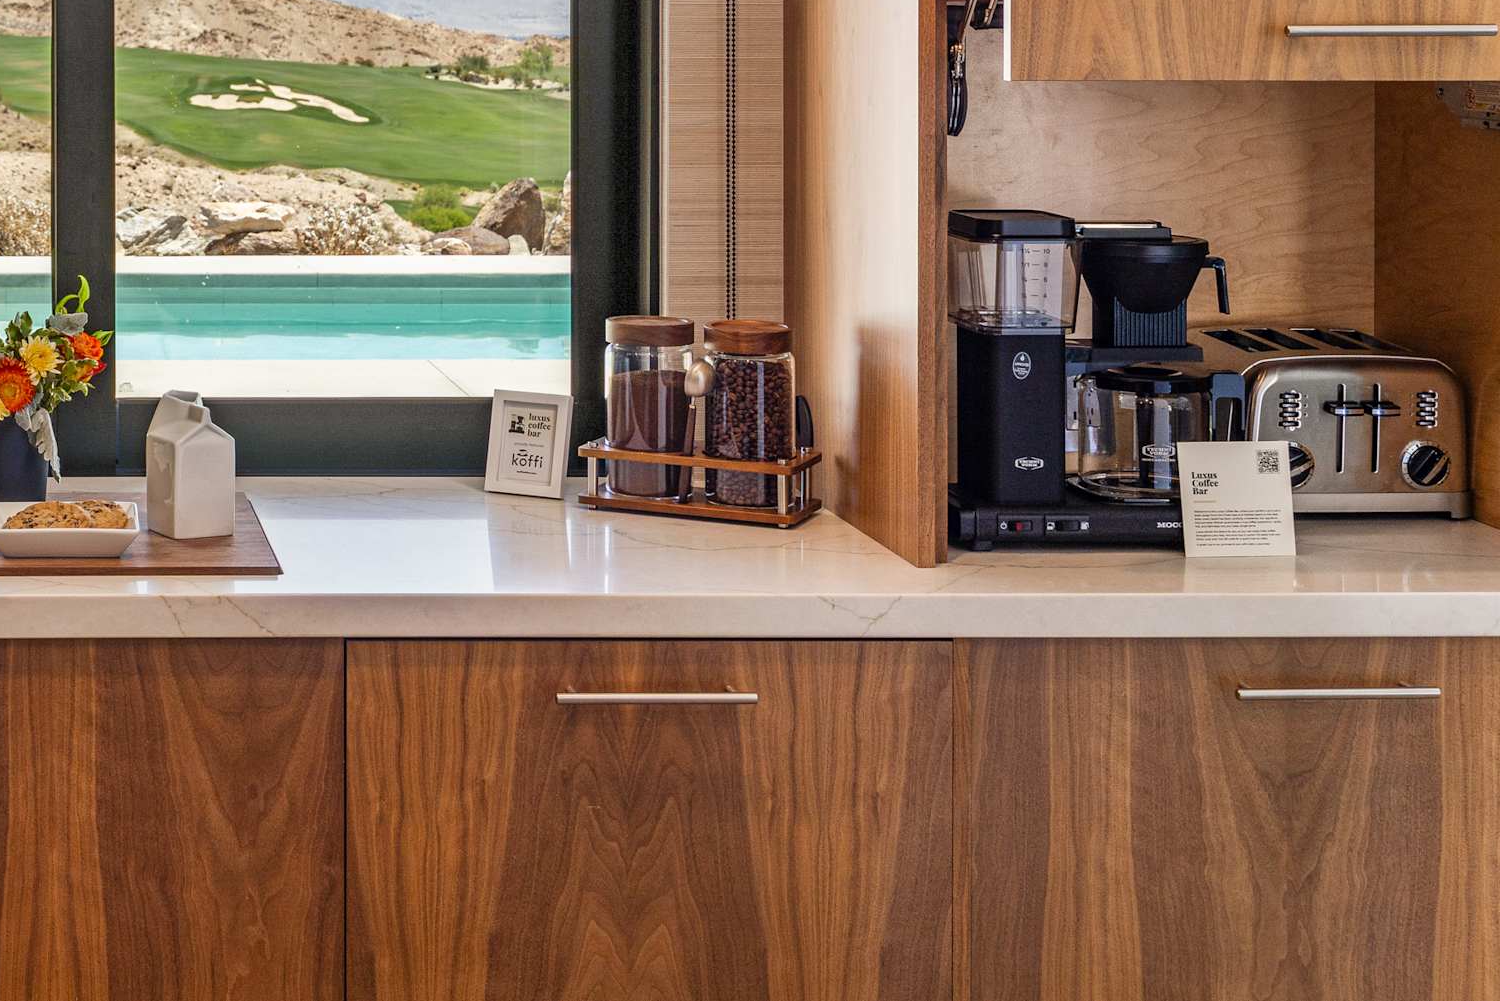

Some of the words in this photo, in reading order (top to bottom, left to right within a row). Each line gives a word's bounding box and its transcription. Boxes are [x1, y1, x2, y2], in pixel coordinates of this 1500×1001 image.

[528, 412, 551, 422] luxus
[528, 422, 551, 430] coffee
[527, 429, 542, 437] bar
[1192, 479, 1219, 487] Coffee
[1192, 487, 1209, 495] Bar
